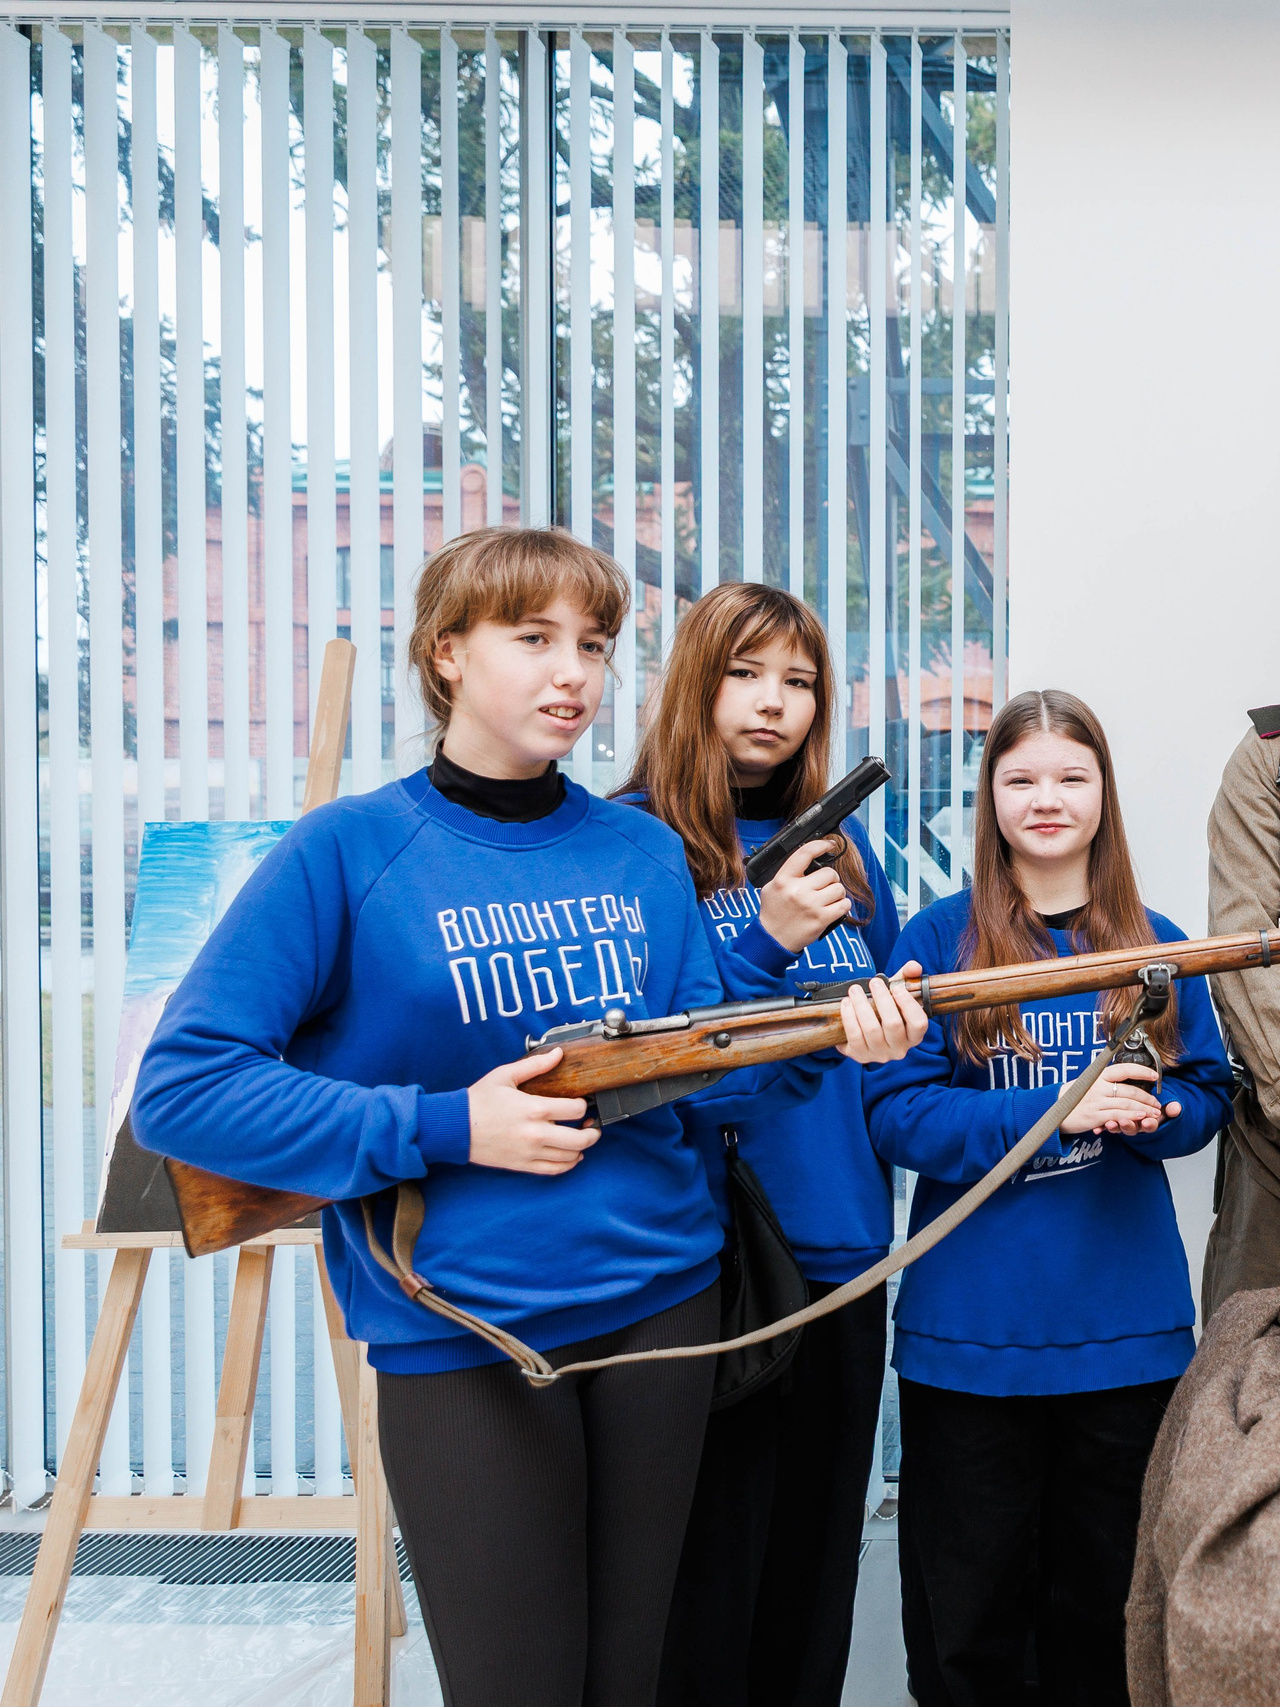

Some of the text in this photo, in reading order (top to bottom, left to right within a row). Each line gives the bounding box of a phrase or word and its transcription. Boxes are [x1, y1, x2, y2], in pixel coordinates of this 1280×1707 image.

[437, 894, 646, 952] ВОЛОНТЕРЫ
[449, 939, 648, 1024] ПОБЕДЫ
[988, 1048, 1106, 1091] ПОБЕ
